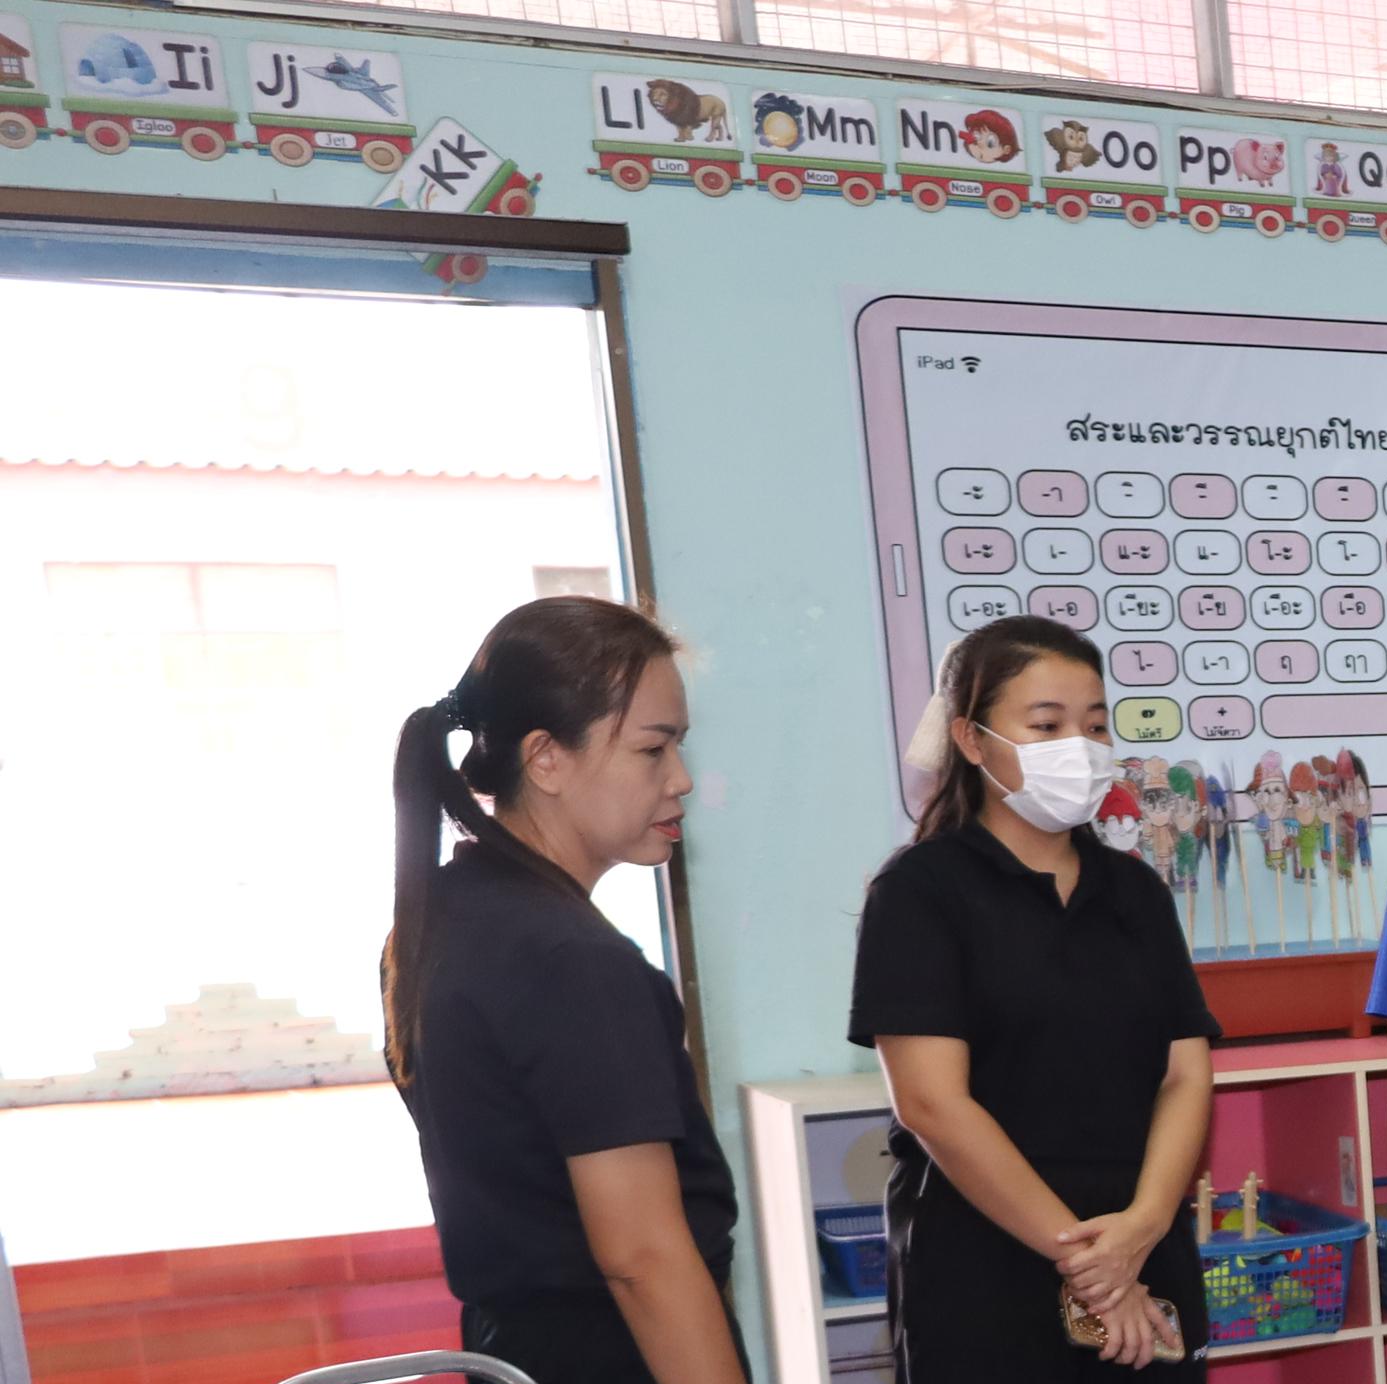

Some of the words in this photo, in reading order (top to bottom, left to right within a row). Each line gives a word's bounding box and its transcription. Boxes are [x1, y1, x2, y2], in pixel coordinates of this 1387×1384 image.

[162, 42, 214, 91] Ii
[257, 53, 299, 108] Jj
[136, 119, 173, 133] Igloo
[325, 133, 347, 147] Jet
[806, 107, 876, 147] Mm
[900, 111, 958, 153] Nn
[419, 133, 487, 195] Kk
[656, 160, 685, 172] Lion
[1102, 130, 1158, 171] Oo
[1180, 135, 1231, 184] Pp
[917, 355, 954, 371] iPad
